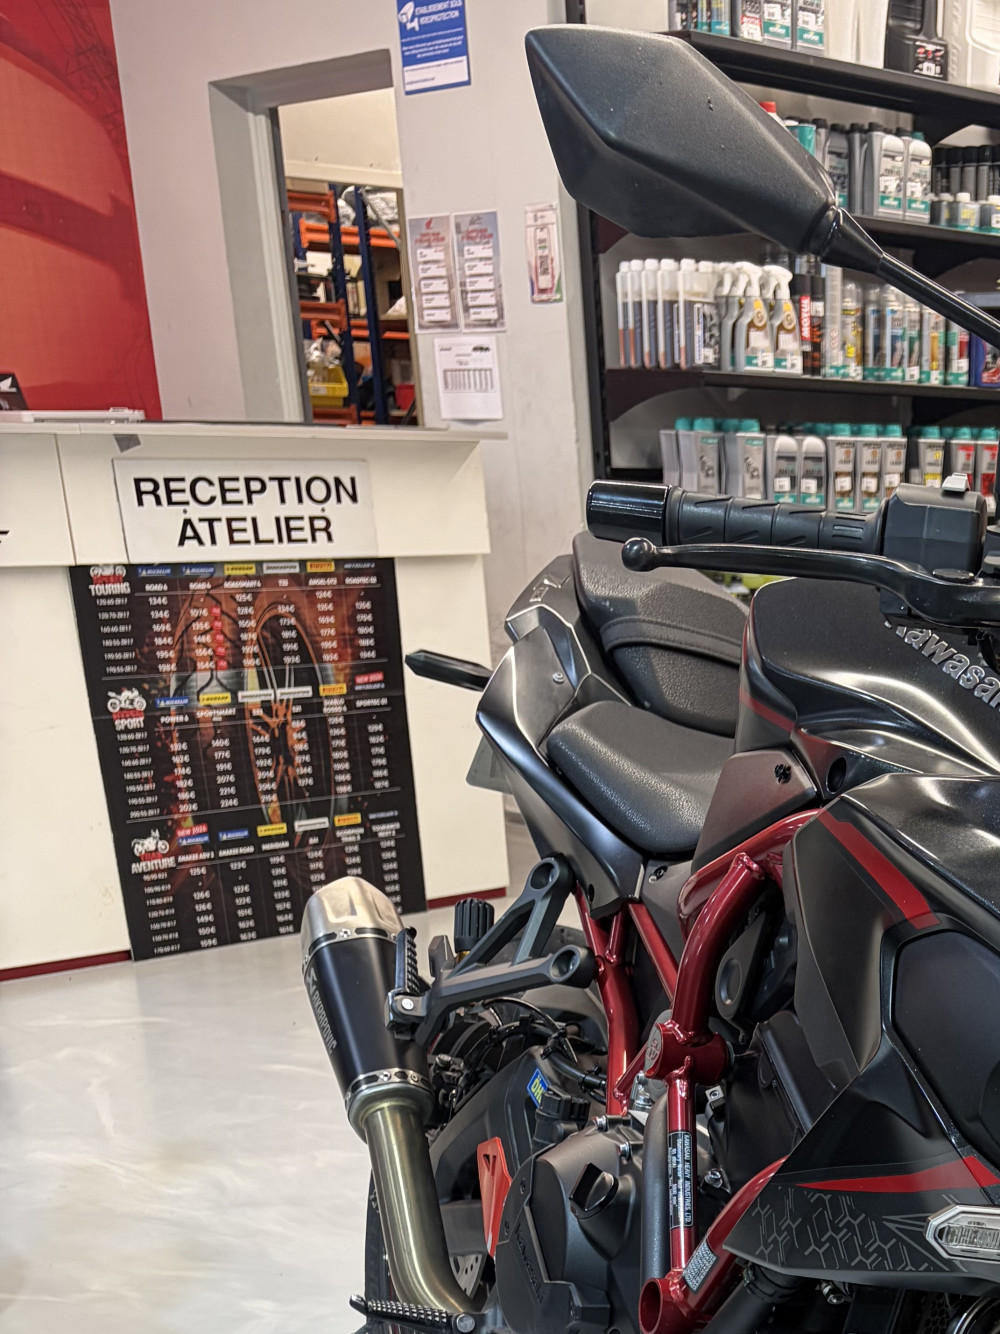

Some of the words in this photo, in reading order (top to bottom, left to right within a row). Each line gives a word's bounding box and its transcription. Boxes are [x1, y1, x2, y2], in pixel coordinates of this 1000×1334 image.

[800, 296, 811, 341] MOTUL
[133, 474, 360, 509] RECEPTION
[178, 513, 335, 549] ATELIER
[88, 582, 131, 596] TOURING
[114, 716, 145, 731] SPORT
[130, 856, 177, 874] AVENTURE
